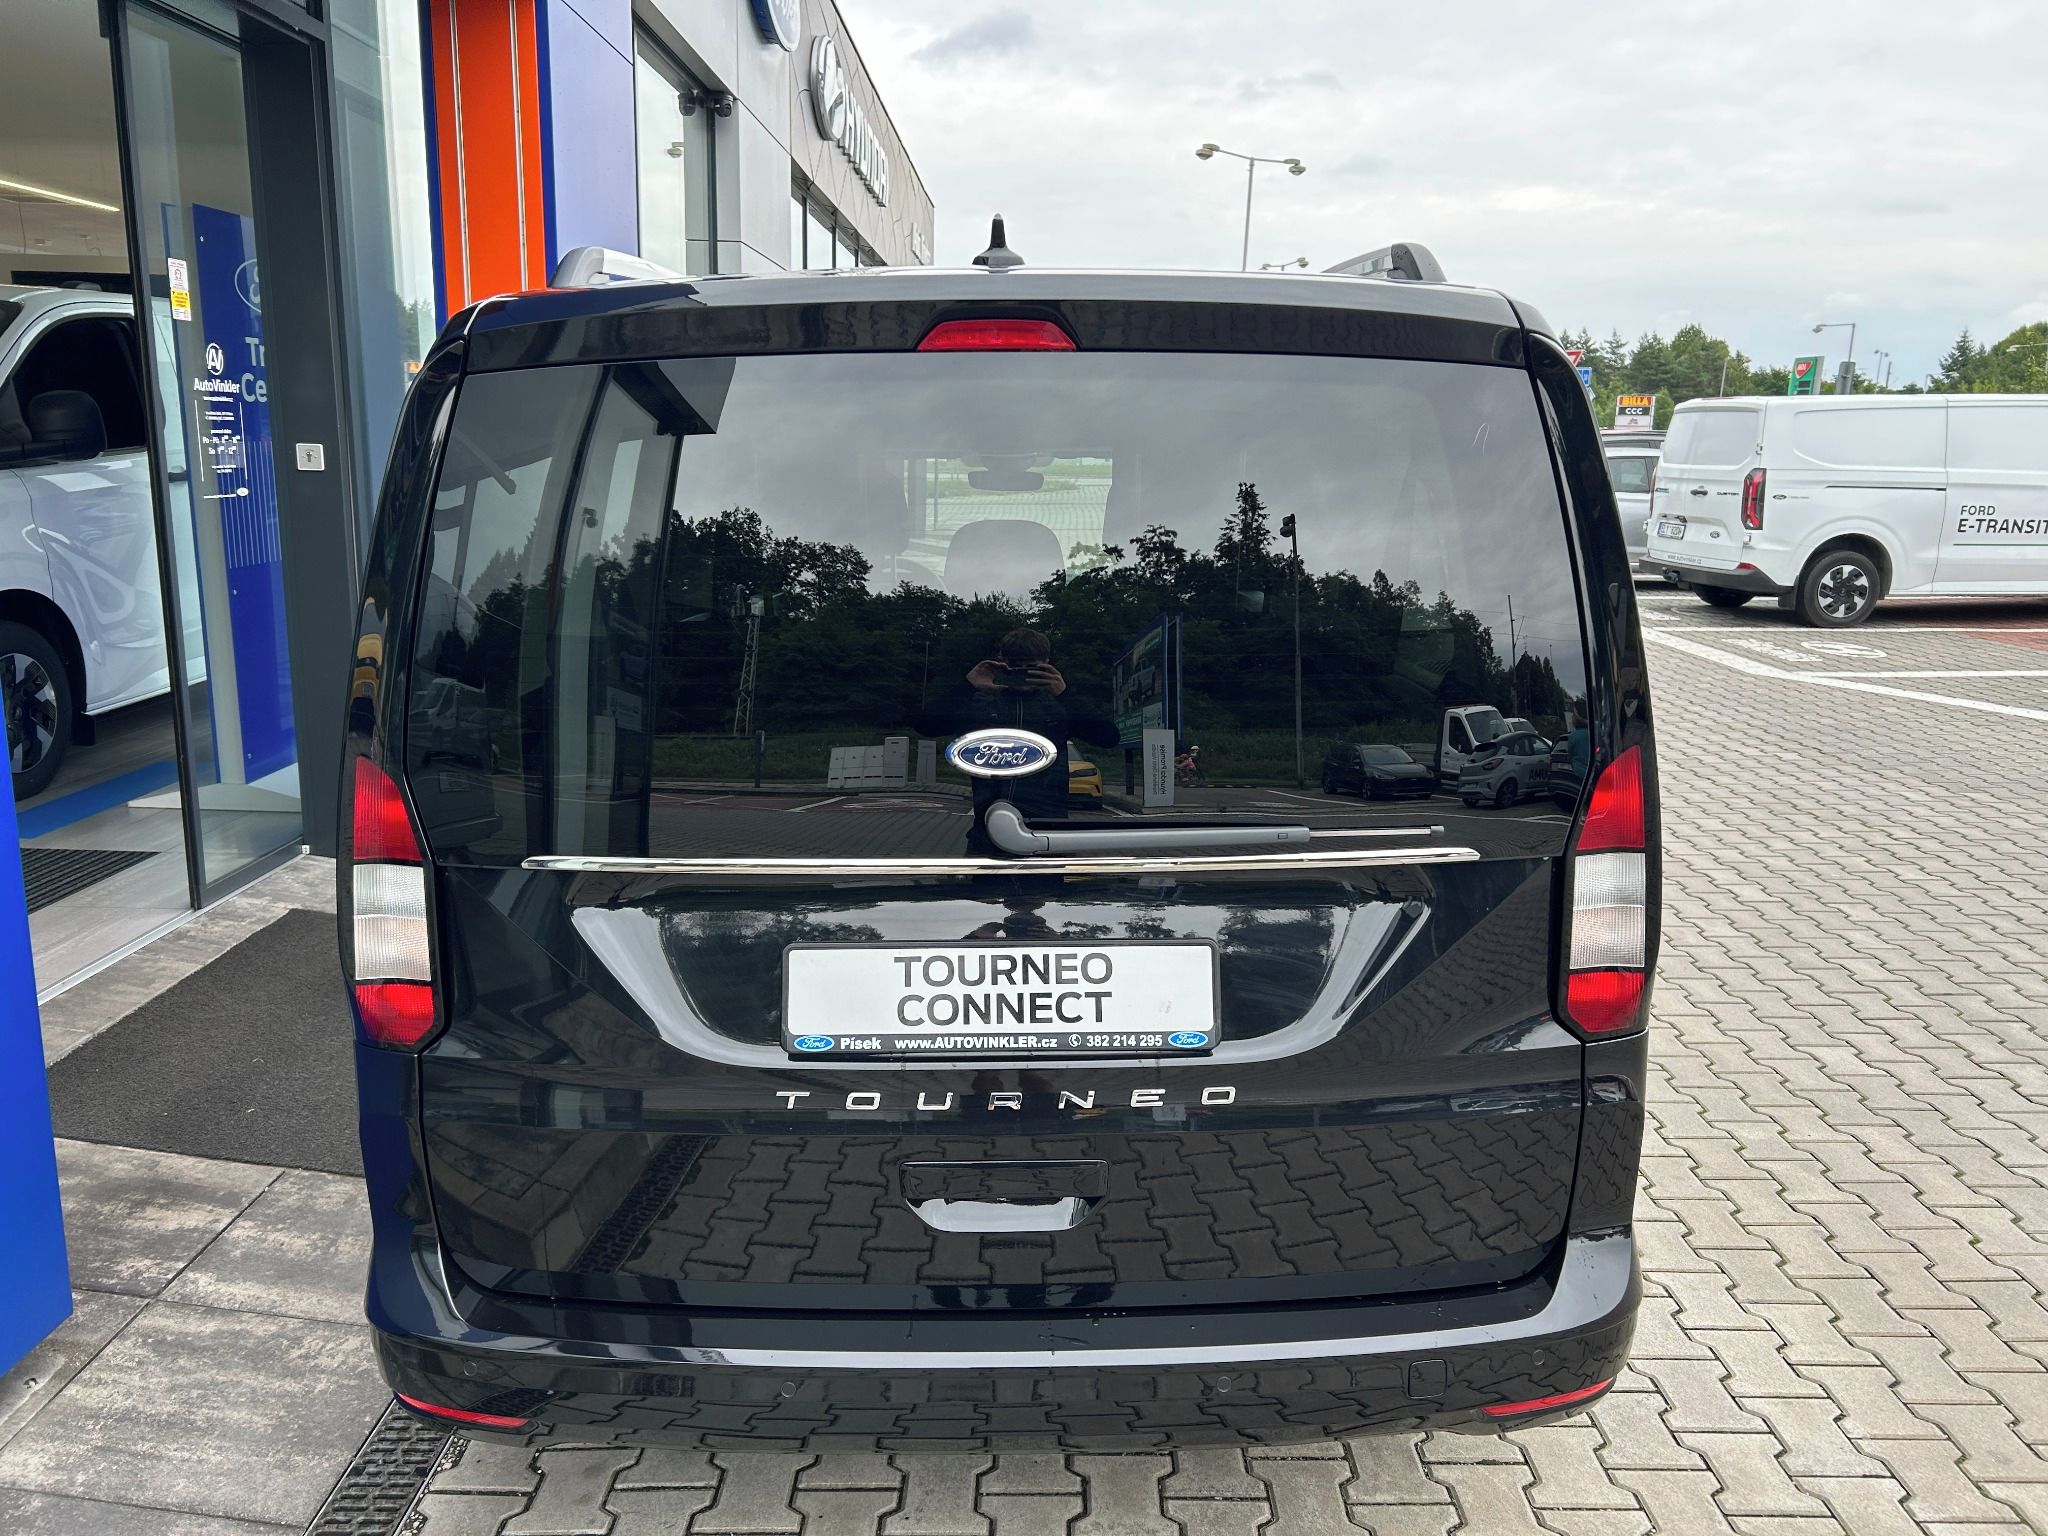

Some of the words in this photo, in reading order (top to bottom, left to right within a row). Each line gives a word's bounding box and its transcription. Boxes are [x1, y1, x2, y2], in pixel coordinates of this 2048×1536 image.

[194, 378, 240, 393] AutoVinkler
[1623, 396, 1649, 405] BILLA
[1625, 407, 1643, 415] CCC
[1961, 505, 1996, 516] FORD
[974, 742, 1028, 765] Ford
[894, 953, 1113, 987] TOURNEO
[897, 991, 1113, 1027] CONNECT
[840, 1036, 882, 1050] Písek
[894, 1035, 1058, 1050] www.AUTOVINKLER.cz
[1086, 1035, 1109, 1047] 382
[1113, 1035, 1137, 1047] 214
[1140, 1034, 1163, 1047] 295
[776, 1086, 1236, 1111] TOURNEO
